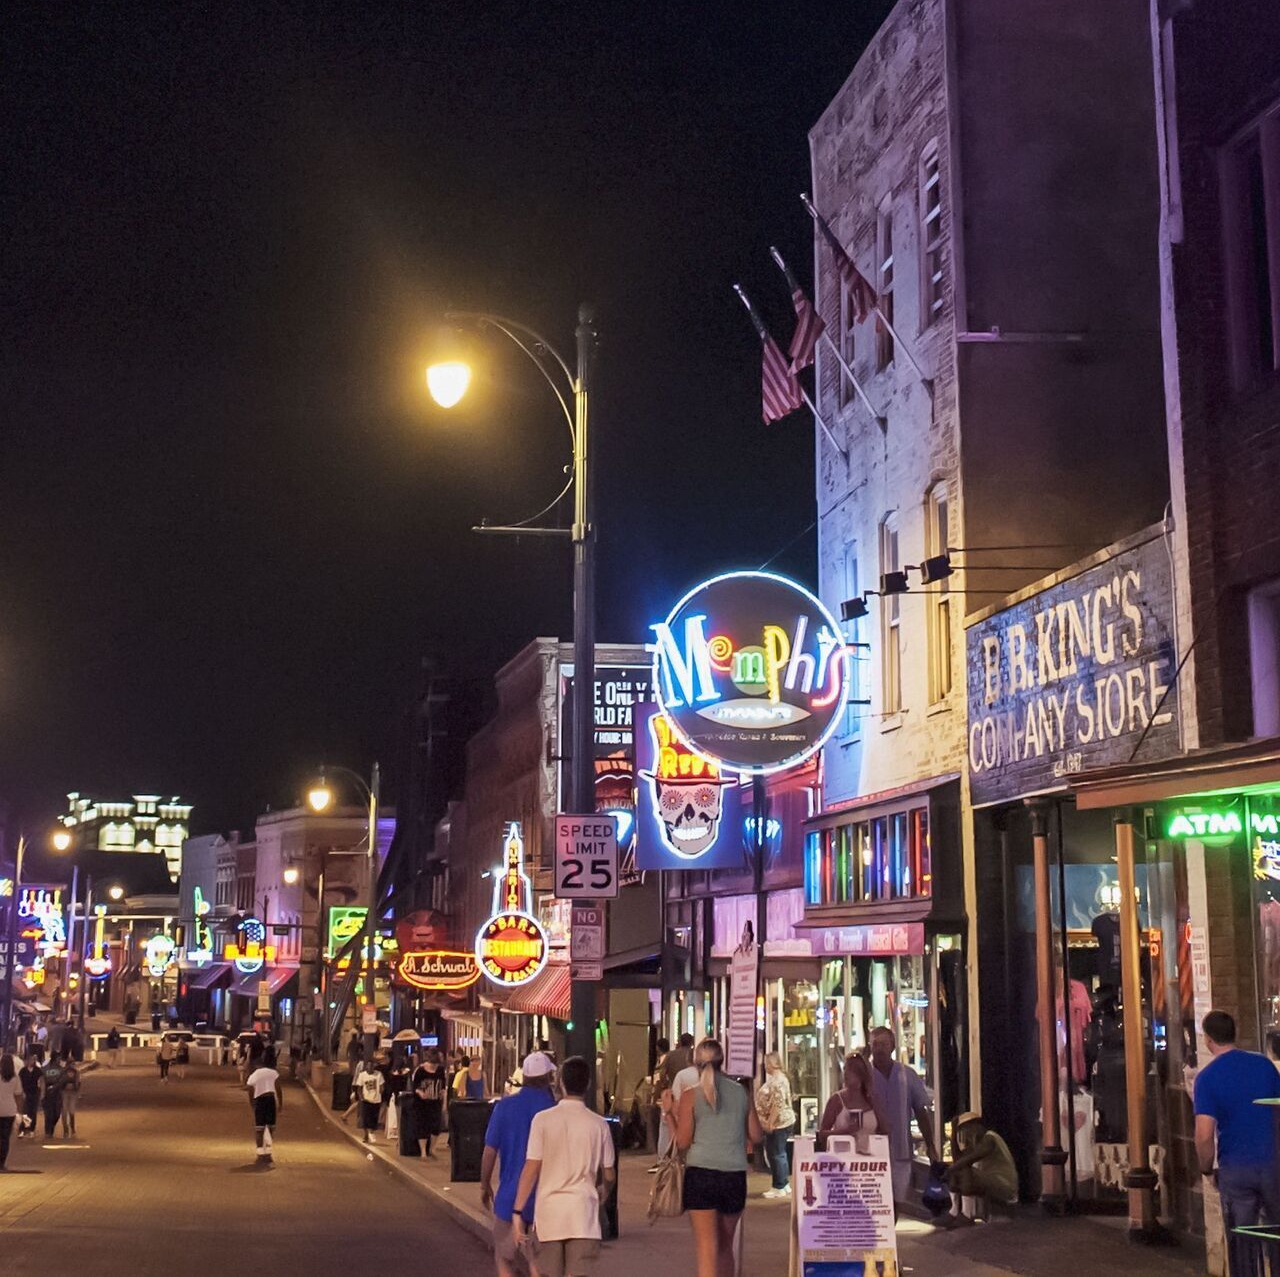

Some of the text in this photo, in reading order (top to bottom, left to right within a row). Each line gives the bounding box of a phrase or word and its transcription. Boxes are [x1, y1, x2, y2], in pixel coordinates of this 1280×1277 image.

[649, 615, 857, 708] Memphis
[605, 682, 648, 705] ONLY
[1077, 662, 1172, 744] STORE
[594, 707, 617, 725] RLD
[560, 825, 613, 838] SPEED
[1169, 812, 1242, 836] ATM
[566, 842, 606, 855] LIMIT
[561, 859, 612, 889] 25
[495, 916, 529, 931] BAR
[577, 912, 597, 923] NO
[421, 955, 475, 974] Schwab
[800, 1162, 888, 1172] HAPPY HOUR
